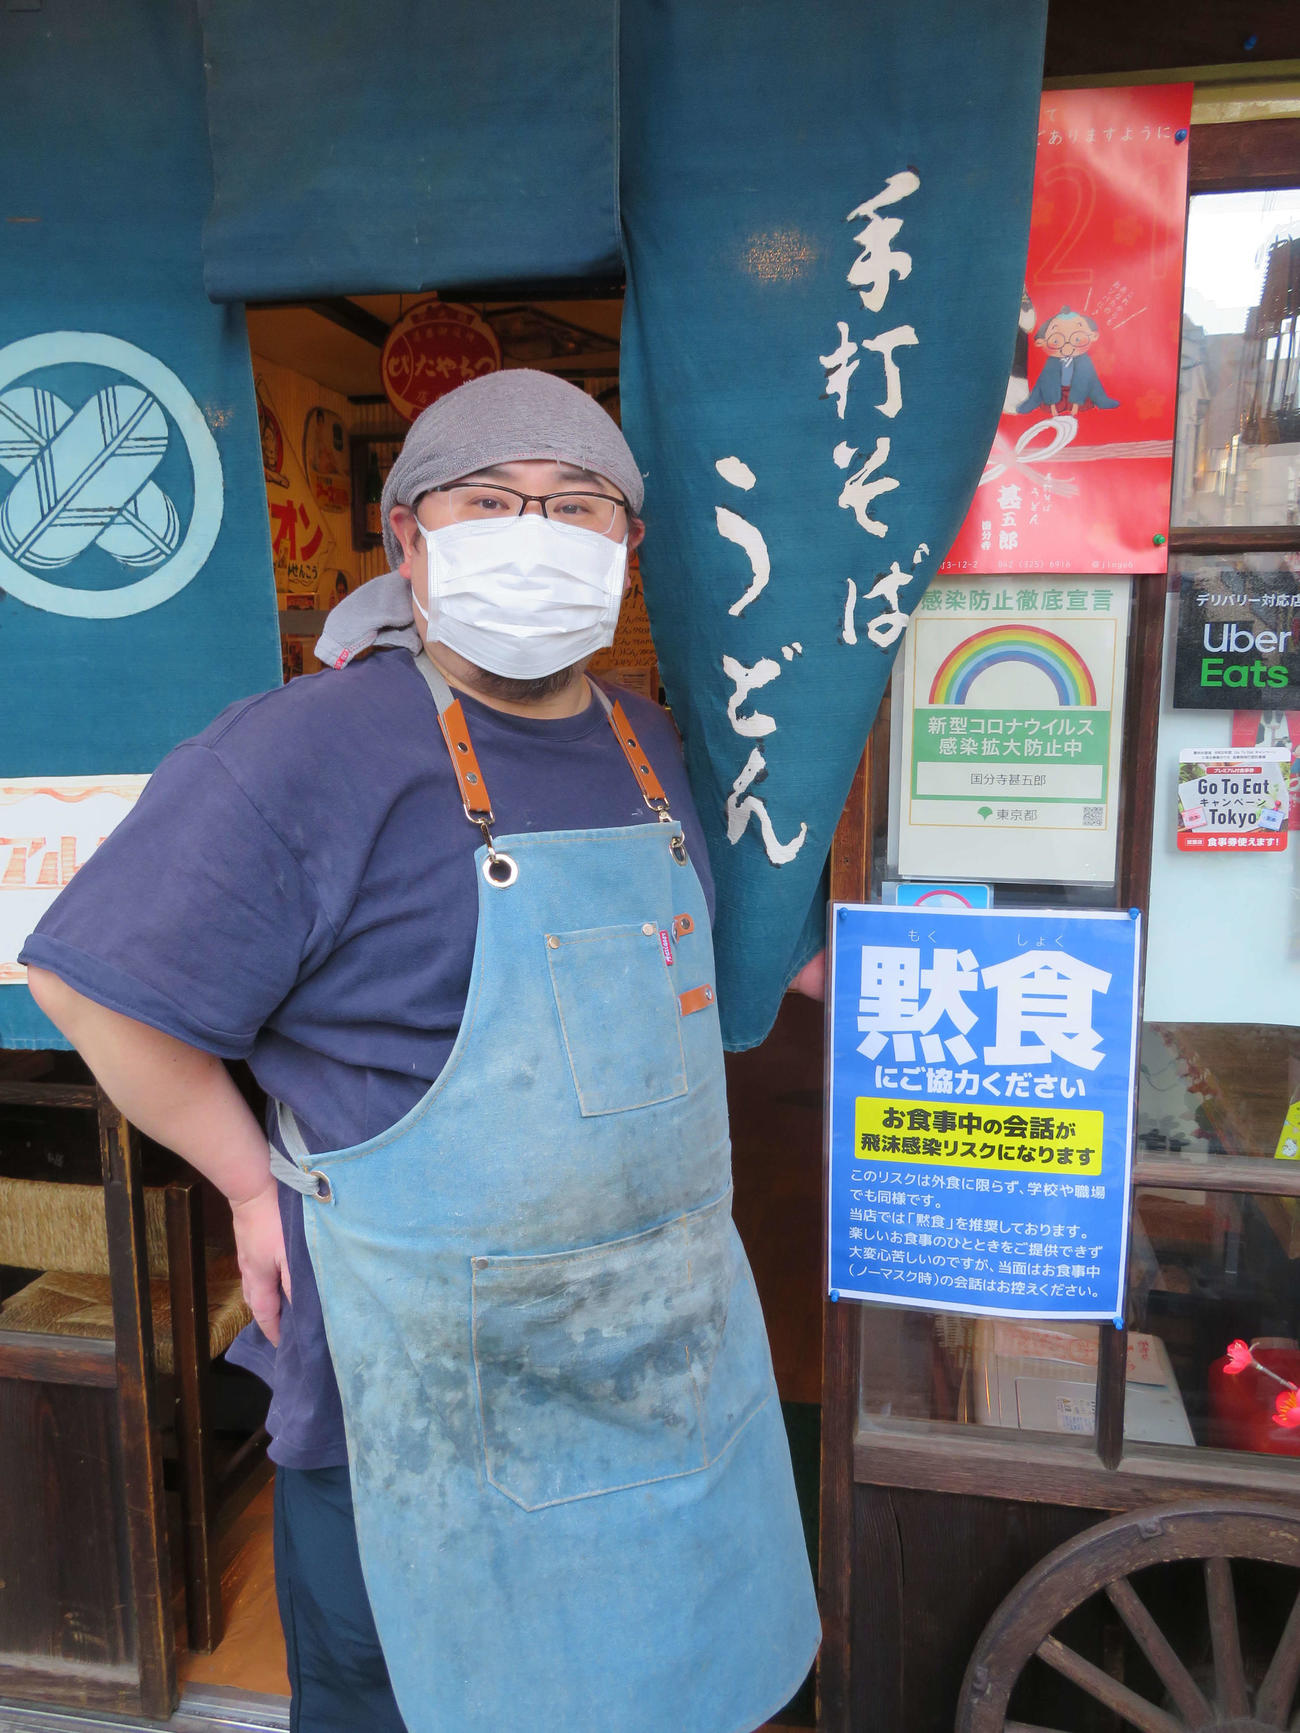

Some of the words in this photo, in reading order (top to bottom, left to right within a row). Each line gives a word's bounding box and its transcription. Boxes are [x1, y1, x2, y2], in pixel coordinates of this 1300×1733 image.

[819, 171, 930, 649] 手打そば
[267, 500, 323, 561] オン
[997, 484, 1023, 551] 甚五郎
[920, 588, 1114, 612] 感染防止徹底宣言
[1196, 592, 1300, 608] デリバリー対応店
[1203, 623, 1292, 653] Uber
[714, 455, 808, 865] うどん
[1200, 658, 1289, 688] Eats
[928, 716, 1095, 736] 新型コロナウイルス
[938, 737, 1083, 758] 感染拡大防止中
[970, 773, 1047, 787] 国分寺甚五郎
[1198, 778, 1218, 795] Go
[1221, 778, 1239, 795] To
[1243, 778, 1270, 795] Eat
[995, 808, 1038, 822] 東京都
[1199, 798, 1267, 808] キャンペーン
[1209, 808, 1257, 829] Tokyo
[908, 930, 937, 944] もく
[1017, 933, 1064, 948] しょく
[856, 945, 1113, 1071] 黙食
[875, 1065, 1086, 1098] にご協力ください
[882, 1107, 1076, 1141] お食事中の会話が
[860, 1133, 1096, 1166] 飛沫感染リスクになります
[850, 1169, 1106, 1200] このリスクは外食に限らず、学校や職場
[850, 1189, 942, 1209] でも同様です。
[849, 1208, 1088, 1240] 当店では「黙食」を推奨しております。
[849, 1227, 1104, 1259] 楽しいお食事のひとときをご提供できず
[849, 1245, 1101, 1279] 大変心苦しいのですが、当面はお食事中
